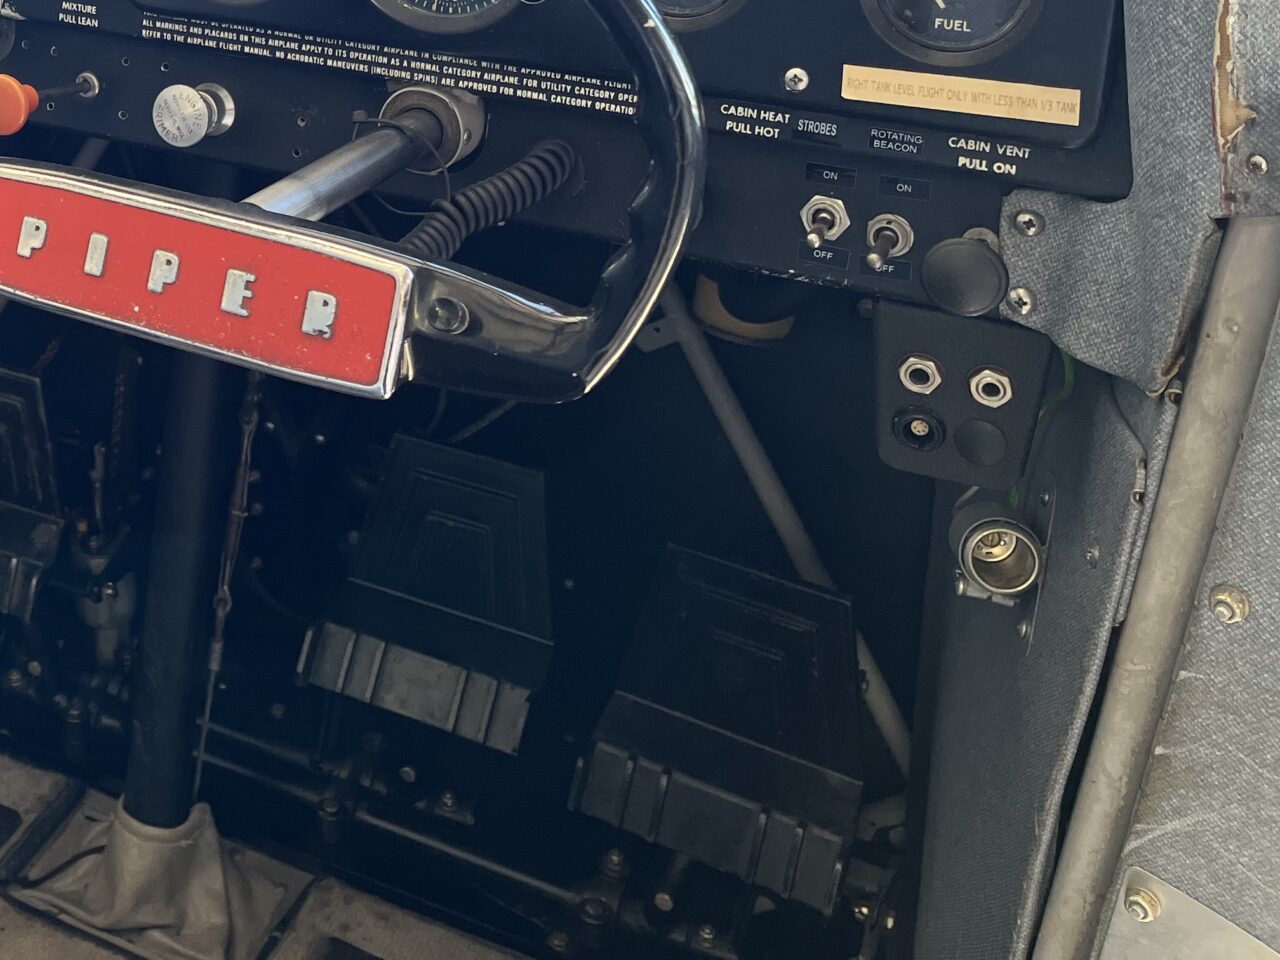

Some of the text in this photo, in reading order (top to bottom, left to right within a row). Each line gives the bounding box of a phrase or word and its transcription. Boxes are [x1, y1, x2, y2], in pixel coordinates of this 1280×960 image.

[62, 1, 97, 15] MIXTURE
[58, 13, 98, 27] PULL LEAN
[935, 18, 971, 32] FUEL
[142, 19, 153, 27] ALL
[156, 21, 187, 32] MARKINGS
[190, 26, 202, 34] AND
[204, 28, 237, 40] PLACARDS
[240, 34, 249, 42] ON
[251, 36, 266, 45] THIS
[268, 38, 299, 50] AIRPLANE
[301, 43, 322, 54] APPLY
[324, 47, 332, 56] TO
[335, 49, 347, 58] ITS
[350, 51, 388, 64] OPERATION
[390, 58, 400, 66] AS
[411, 60, 440, 73] NORMAL
[443, 66, 481, 79] CATEGORY
[523, 78, 537, 88] FOR
[541, 81, 572, 93] UTILITY
[574, 86, 615, 100] CATEGORY
[142, 29, 161, 38] REFER
[173, 34, 185, 43] THE
[187, 36, 217, 48] AIRPLANE
[220, 41, 241, 51] FLIGHT
[287, 52, 324, 65] ACROBATIC
[327, 59, 368, 72] MANEUVERS
[371, 66, 410, 79] (INCLUDING
[413, 72, 438, 85] SPINS)
[441, 78, 455, 87] ARE
[458, 80, 497, 93] APPROVED
[500, 86, 514, 96] FOR
[517, 89, 548, 101] NORMAL
[551, 94, 592, 108] CATEGORY
[595, 101, 636, 115] OPERATIO
[847, 78, 868, 90] RIGHT
[871, 81, 890, 92] TANK
[893, 84, 916, 96] LEVEL
[919, 86, 945, 98] FLIGHT
[947, 88, 968, 101] ONLY
[970, 90, 991, 103] WITH
[993, 94, 1013, 106] LESS
[1015, 96, 1038, 108] THAN
[1055, 100, 1077, 112] TANK
[720, 104, 790, 124] CABIN HEAT
[725, 121, 780, 139] PULL HOT
[798, 119, 837, 136] STROBES
[870, 129, 923, 144] ROTATING
[873, 139, 918, 154] BEACON
[948, 137, 1031, 159] CABIN VENT
[957, 156, 1016, 176] PULL ON
[823, 170, 837, 180] ON
[897, 183, 912, 193] ON
[813, 250, 833, 261] OFF
[16, 215, 337, 339] PIPER
[875, 264, 895, 274] OFF
